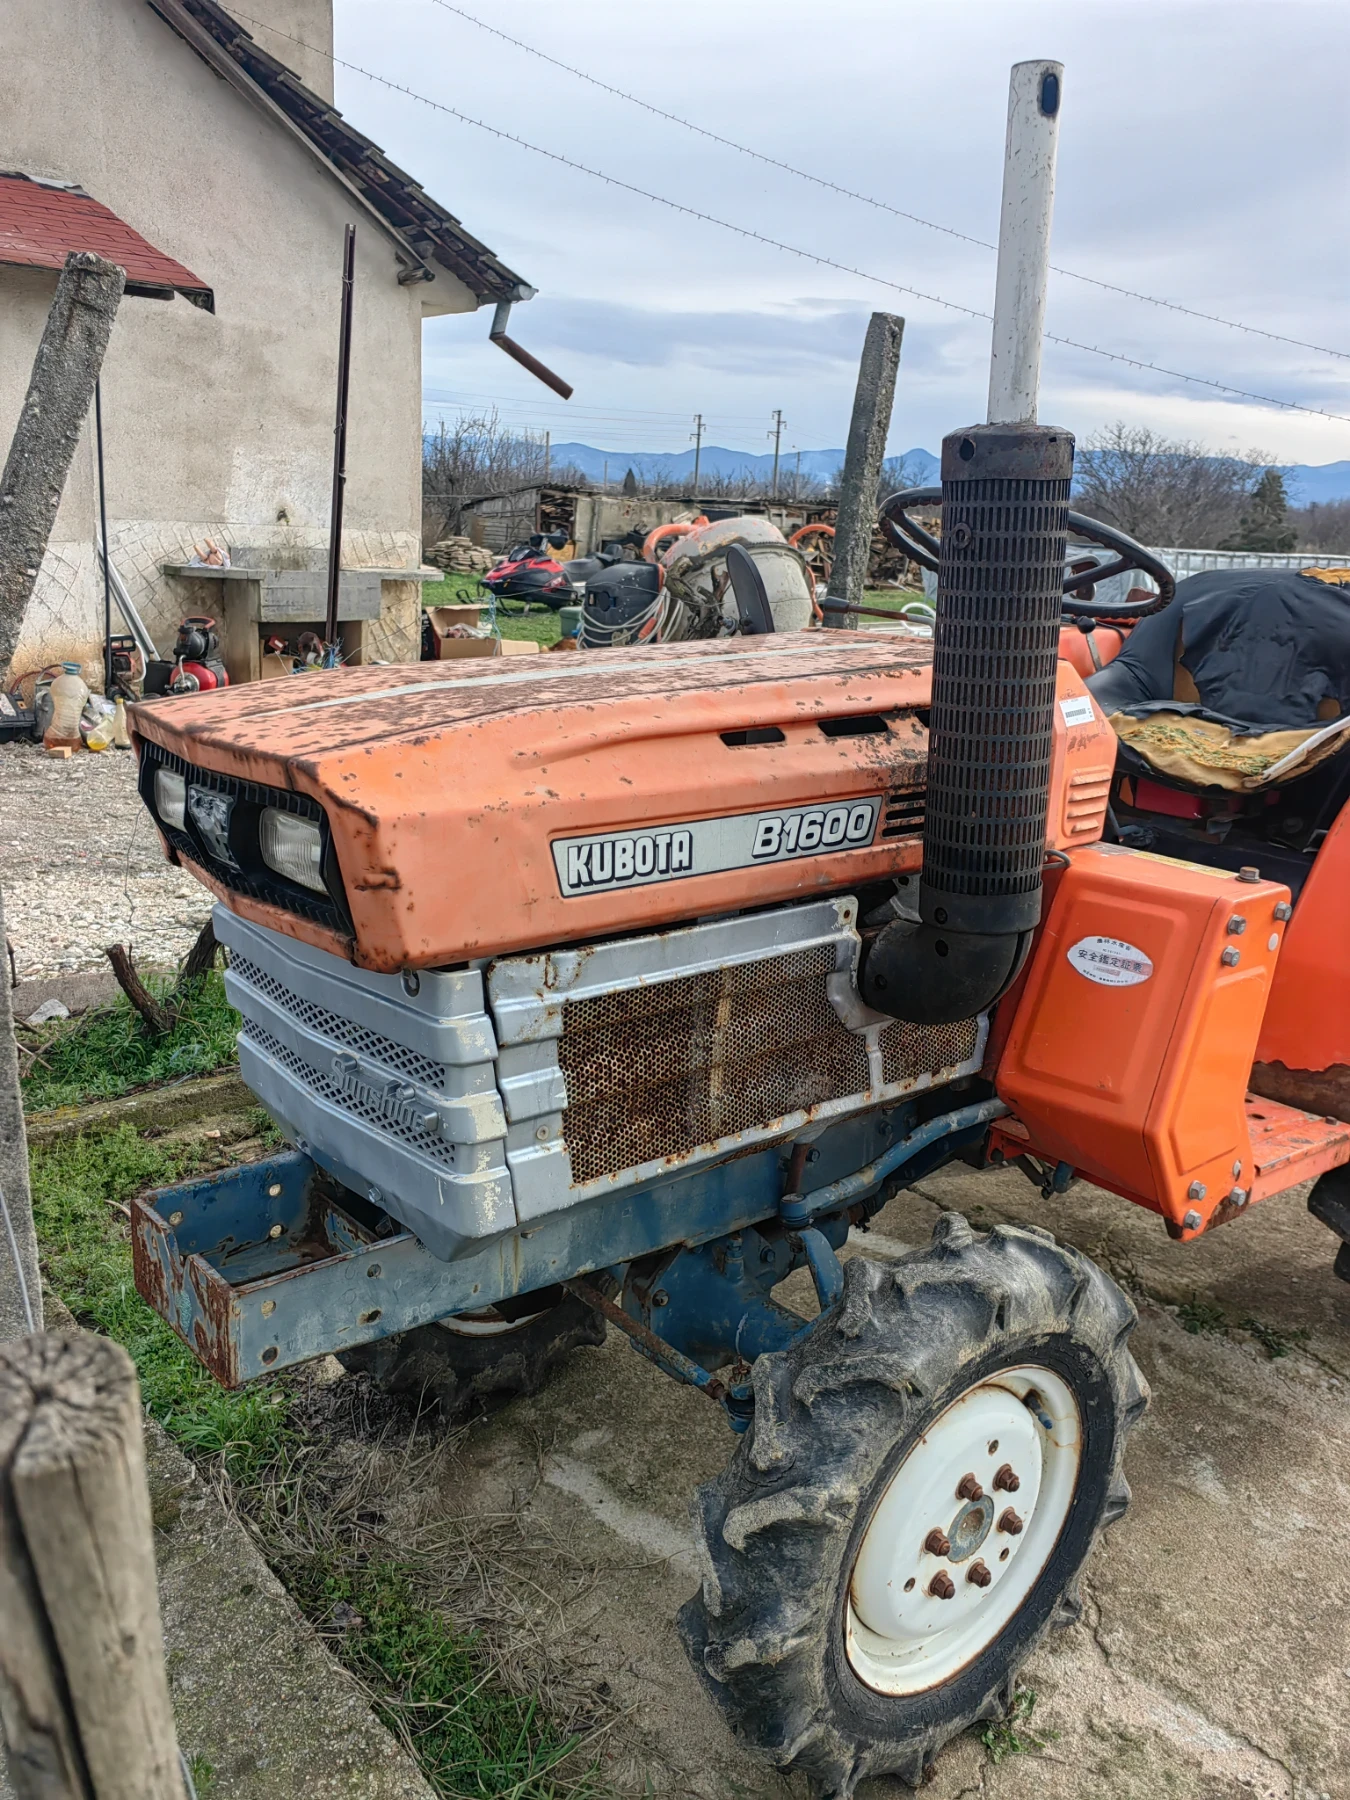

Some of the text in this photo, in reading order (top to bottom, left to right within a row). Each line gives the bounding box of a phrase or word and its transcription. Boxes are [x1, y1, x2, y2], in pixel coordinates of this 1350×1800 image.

[567, 804, 874, 889] KUBOTA B1600
[330, 1055, 433, 1132] Sunshine
